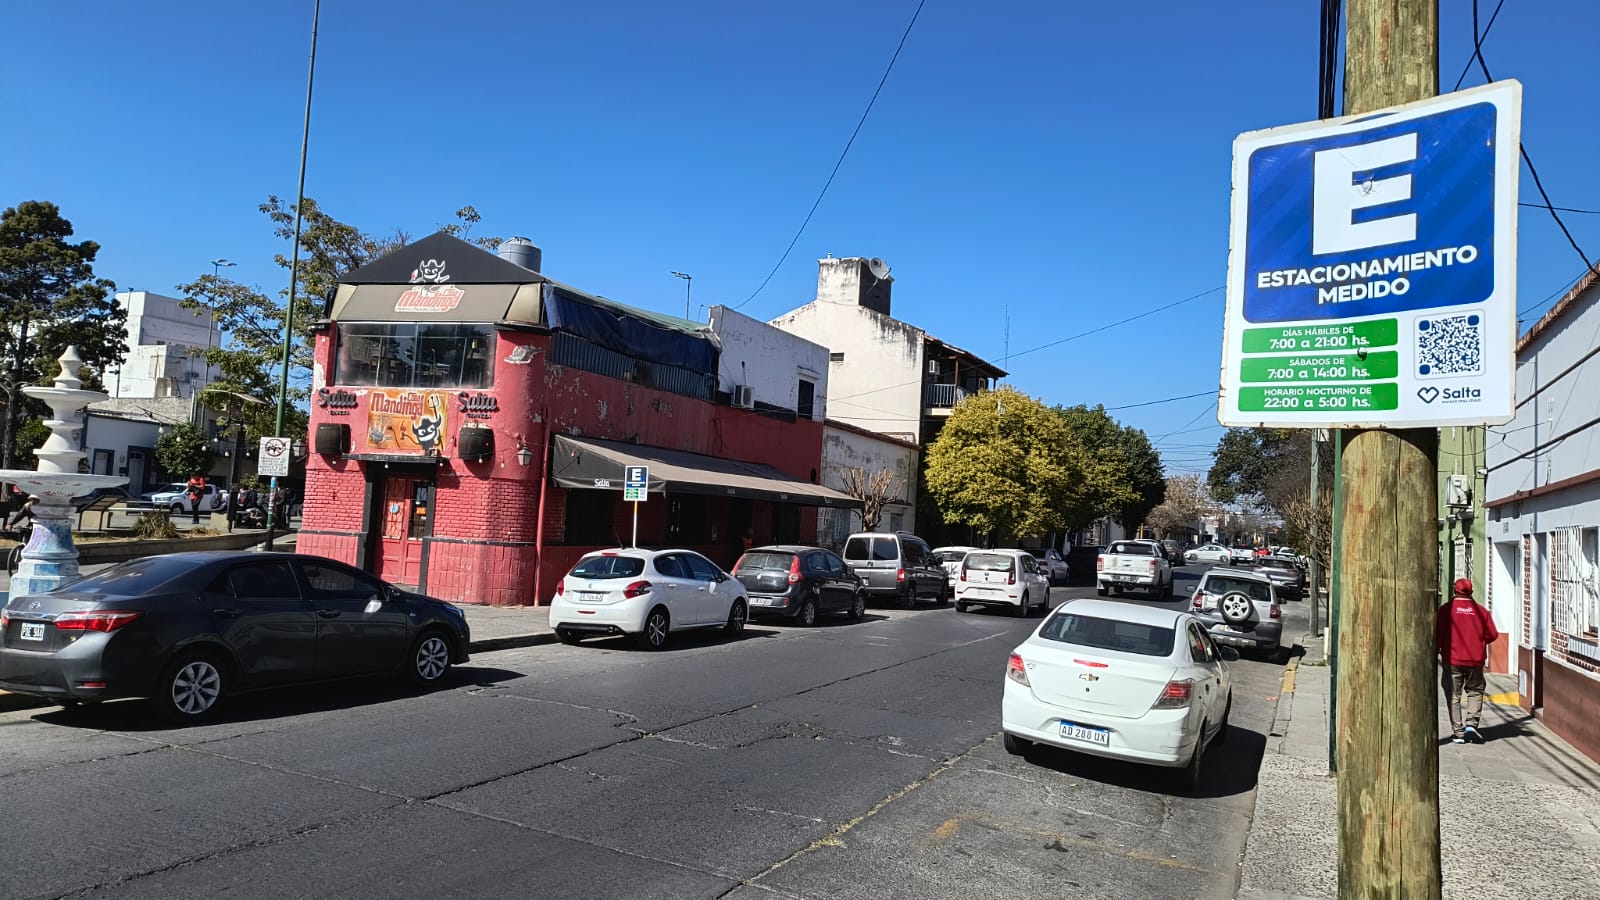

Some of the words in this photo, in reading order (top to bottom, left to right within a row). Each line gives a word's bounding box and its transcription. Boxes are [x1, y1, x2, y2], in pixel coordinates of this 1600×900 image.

[1312, 132, 1417, 255] E
[1257, 244, 1478, 289] ESTACIONAMIENTO
[1318, 277, 1410, 305] MEDIDO
[1282, 327, 1302, 337] DÍAS
[1305, 326, 1340, 336] HÁBILES
[1343, 326, 1354, 334] DE
[1269, 338, 1296, 349] 7:00
[1300, 340, 1310, 348] a
[1314, 336, 1347, 347] 21:00
[1352, 335, 1370, 345] hs.
[1289, 358, 1330, 367] SÁBADOS
[1333, 357, 1345, 365] DE
[1267, 368, 1294, 379] 7:00
[1298, 370, 1308, 378] a
[1312, 367, 1347, 378] 14:00
[1352, 366, 1370, 377] hs.
[317, 388, 359, 409] Salta
[1264, 388, 1304, 396] HORARIO
[1306, 387, 1357, 395] NOCTURNO
[1442, 386, 1480, 399] Salta
[371, 392, 424, 420] Mandinga
[457, 391, 500, 413] Salta
[1263, 397, 1299, 408] 22:00
[1303, 399, 1313, 407] a
[1318, 397, 1347, 407] 5:00
[1352, 396, 1371, 407] hs.
[631, 468, 641, 481] E
[1061, 726, 1073, 736] AD
[1075, 728, 1092, 740] 288
[1094, 732, 1106, 743] UX
